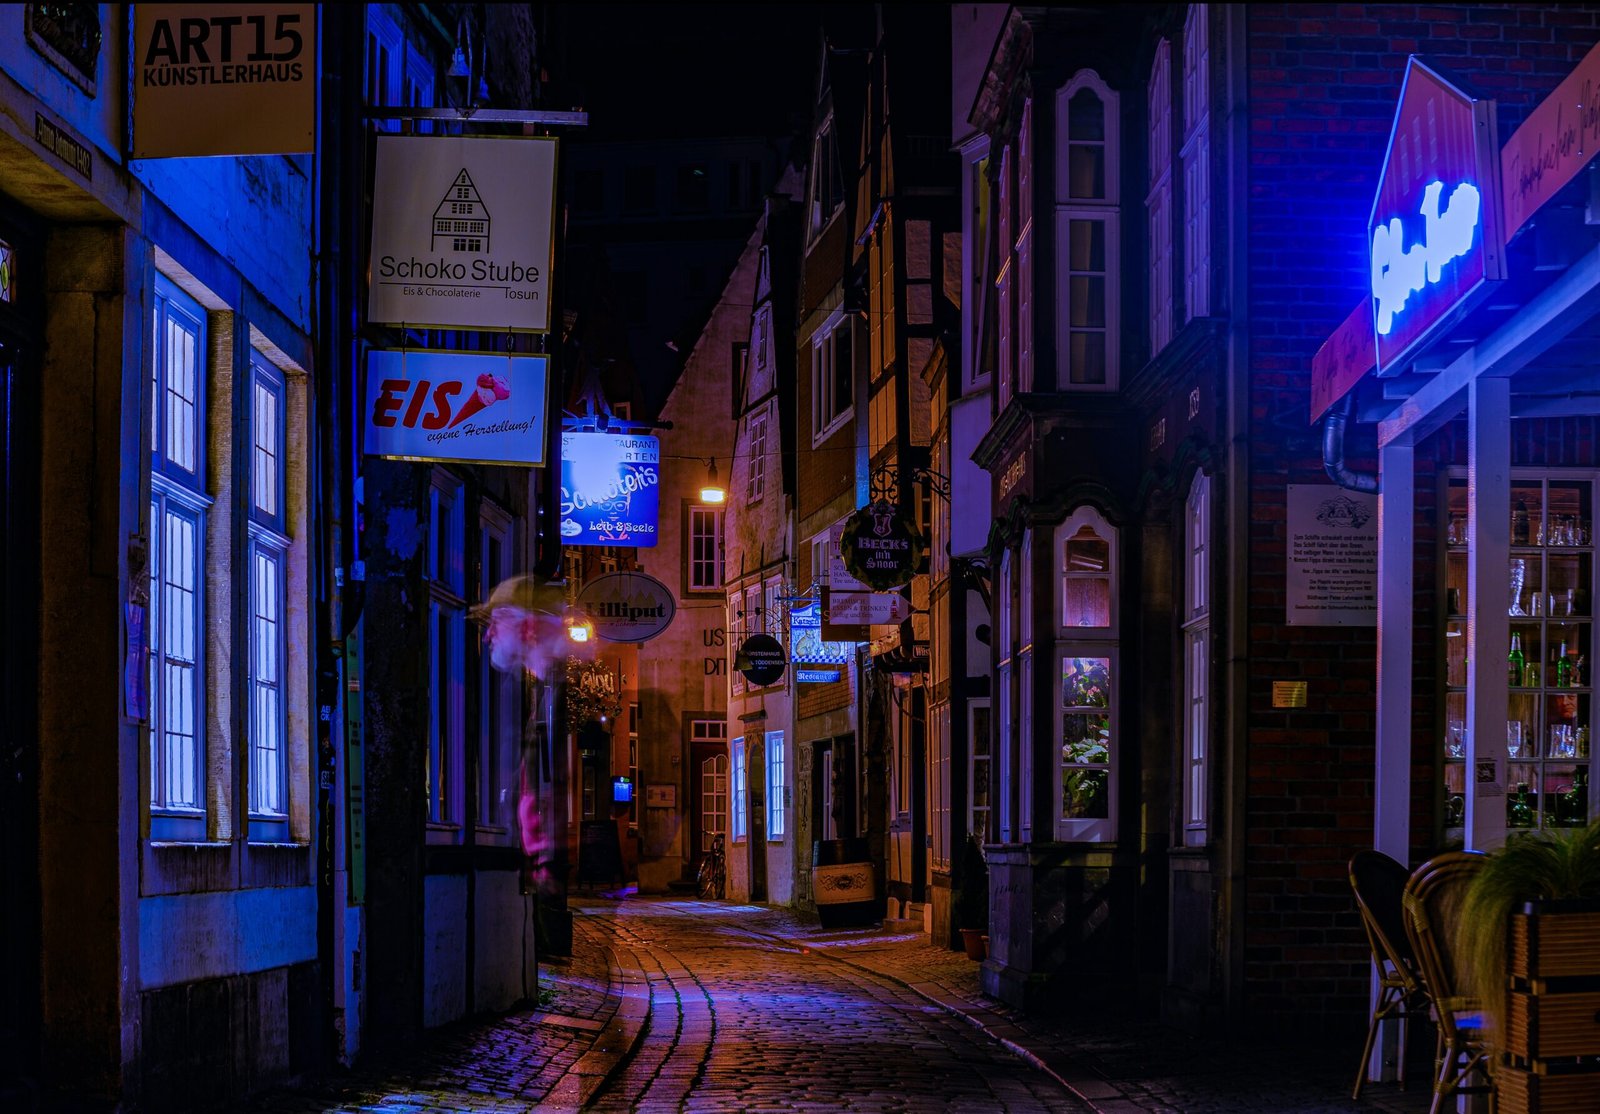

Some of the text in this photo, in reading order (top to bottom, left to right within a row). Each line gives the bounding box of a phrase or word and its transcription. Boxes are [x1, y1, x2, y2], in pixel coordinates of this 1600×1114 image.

[143, 63, 303, 87] KÜNSTLERHAUS
[379, 255, 540, 283] Schoko Stube
[403, 286, 481, 299] Eis & Chocolaterie
[504, 287, 539, 301] Tosun
[373, 379, 463, 430] EIS
[427, 415, 536, 443] eigene Herstellung!
[589, 520, 613, 531] Leib
[615, 522, 624, 532] &
[625, 522, 655, 533] Seele
[584, 602, 667, 622] Lilliput
